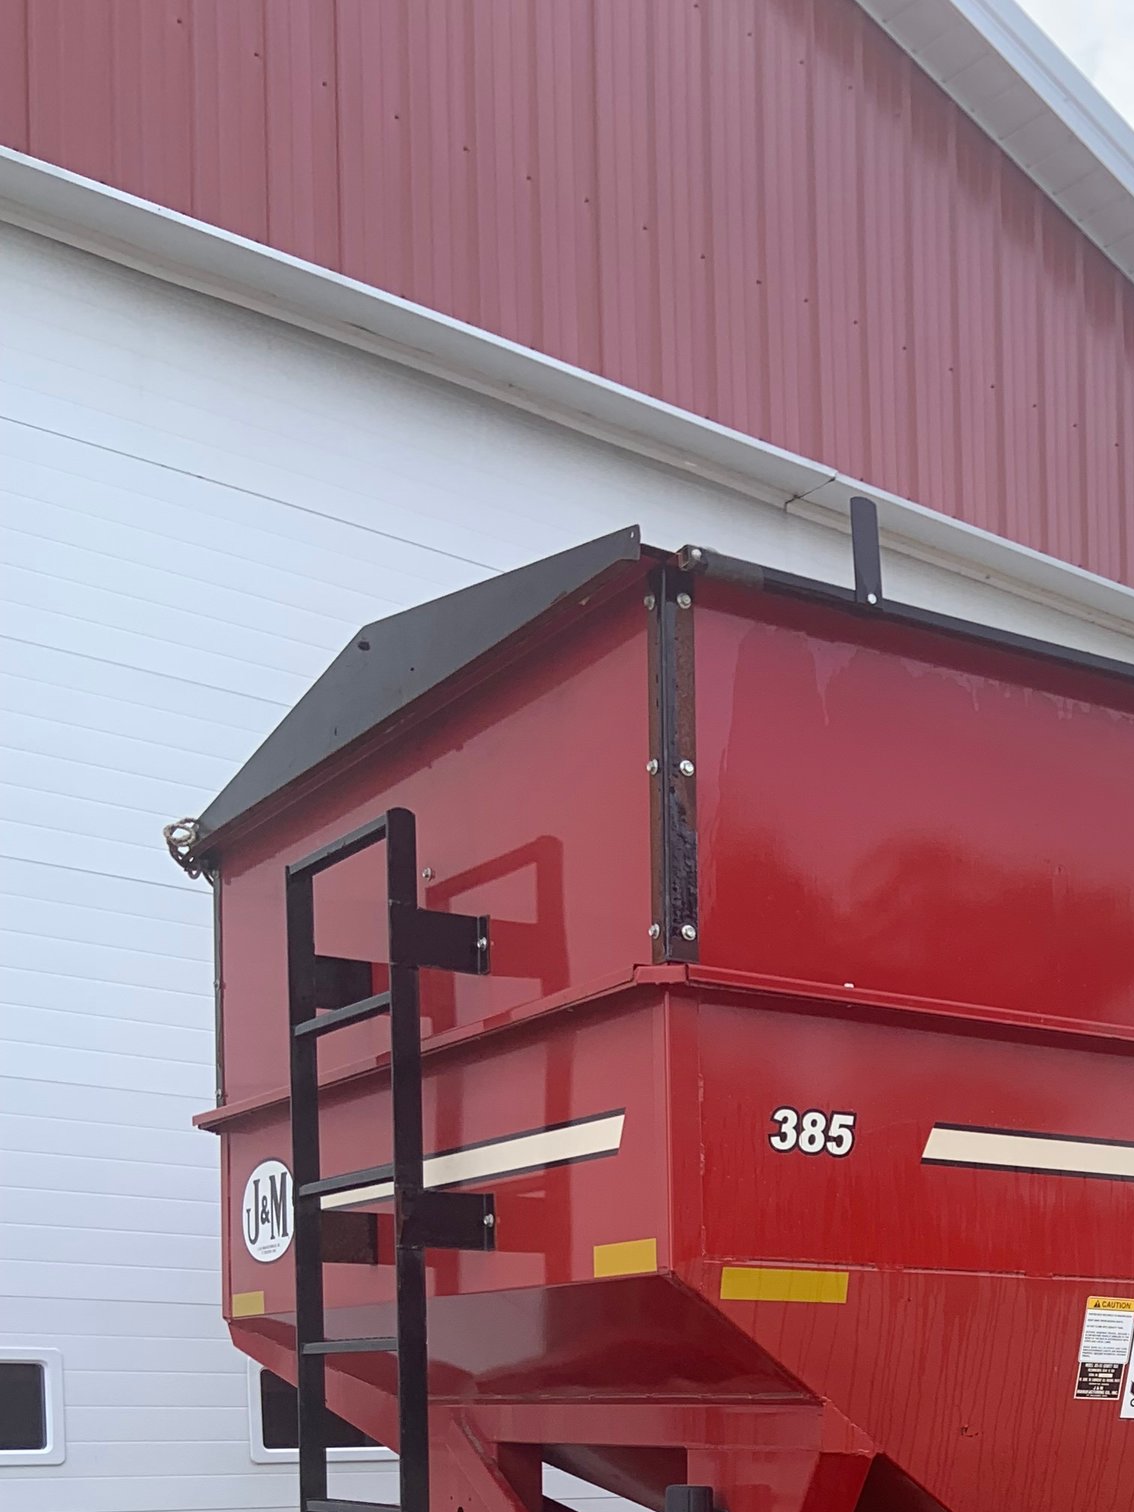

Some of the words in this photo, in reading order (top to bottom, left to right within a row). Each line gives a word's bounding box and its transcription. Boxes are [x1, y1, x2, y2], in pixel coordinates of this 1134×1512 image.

[768, 1107, 856, 1157] 385
[246, 1172, 289, 1245] J&M
[1102, 1302, 1131, 1310] CAUTION
